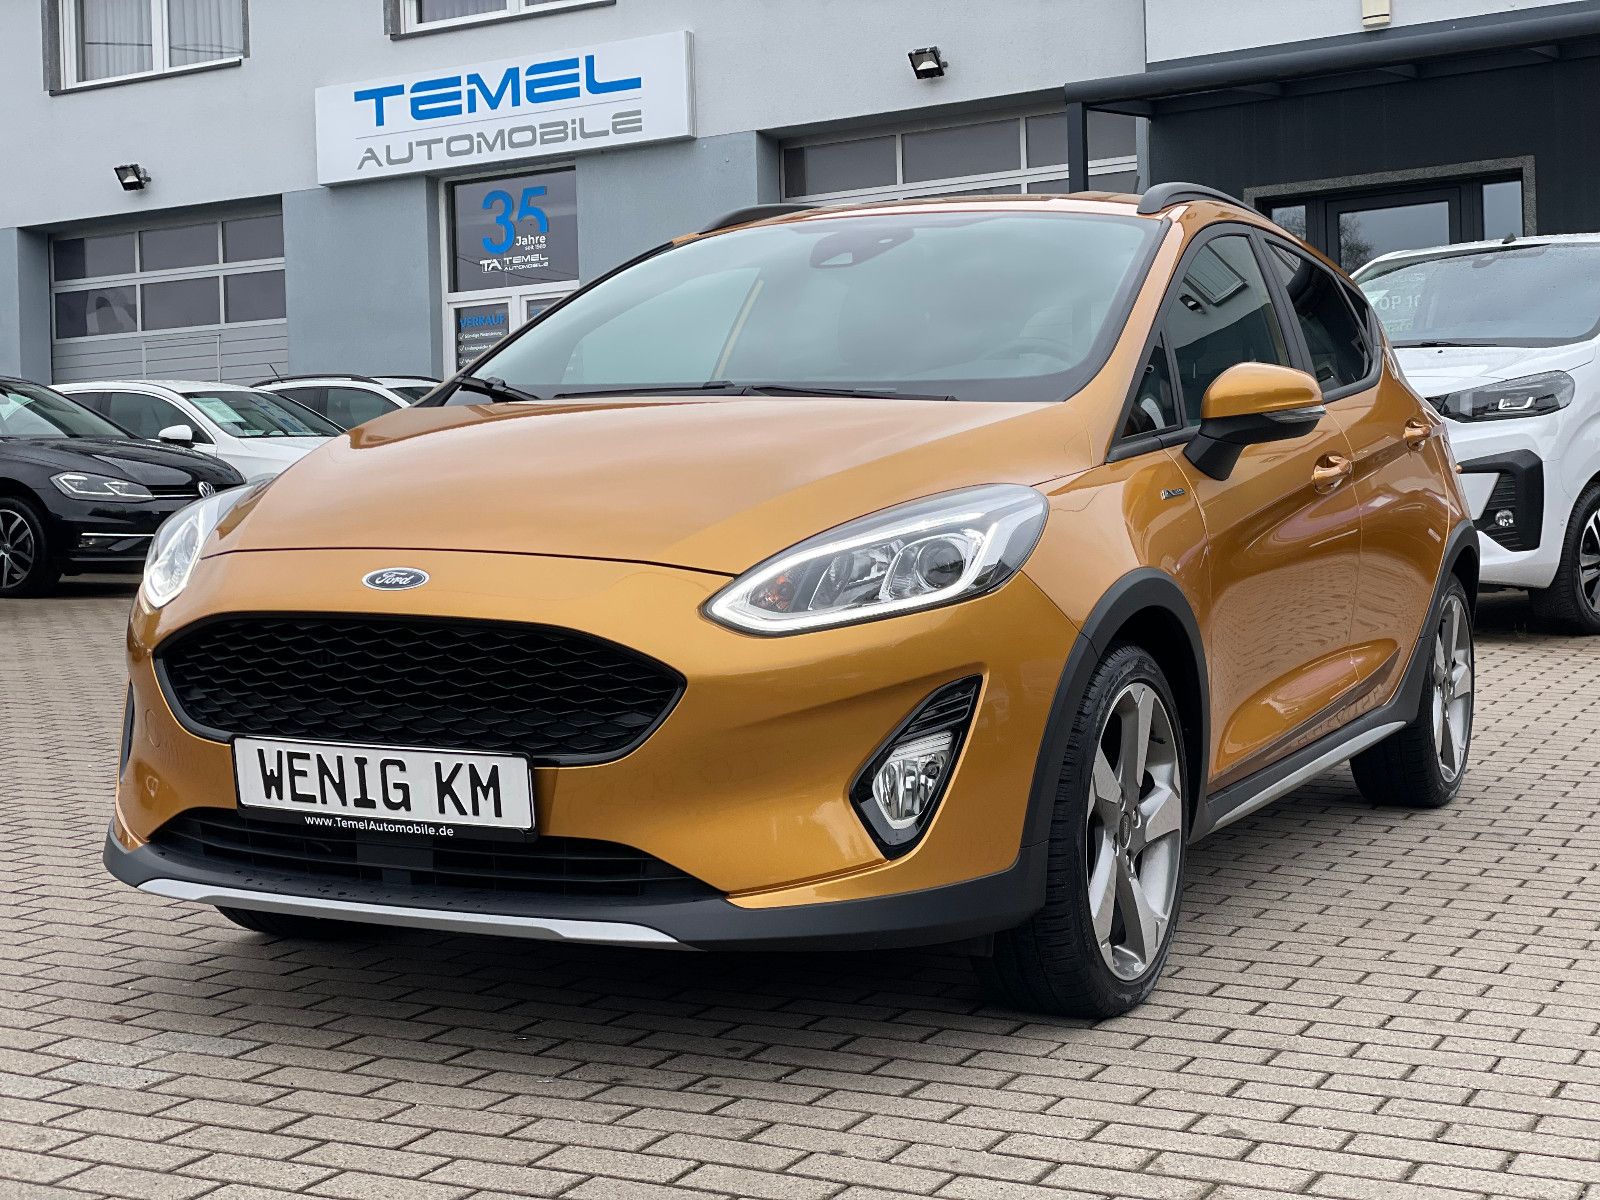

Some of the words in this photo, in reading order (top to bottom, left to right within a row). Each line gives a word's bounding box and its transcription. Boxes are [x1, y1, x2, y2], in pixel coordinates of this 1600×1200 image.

[354, 54, 642, 127] TEMEL
[482, 186, 548, 254] 35
[515, 234, 547, 247] Jahre
[503, 253, 549, 265] TEMEL
[374, 571, 415, 585] Ford
[257, 748, 412, 812] WENIG
[434, 761, 503, 818] KM
[304, 815, 454, 837] www.TemelAutomobile.de
